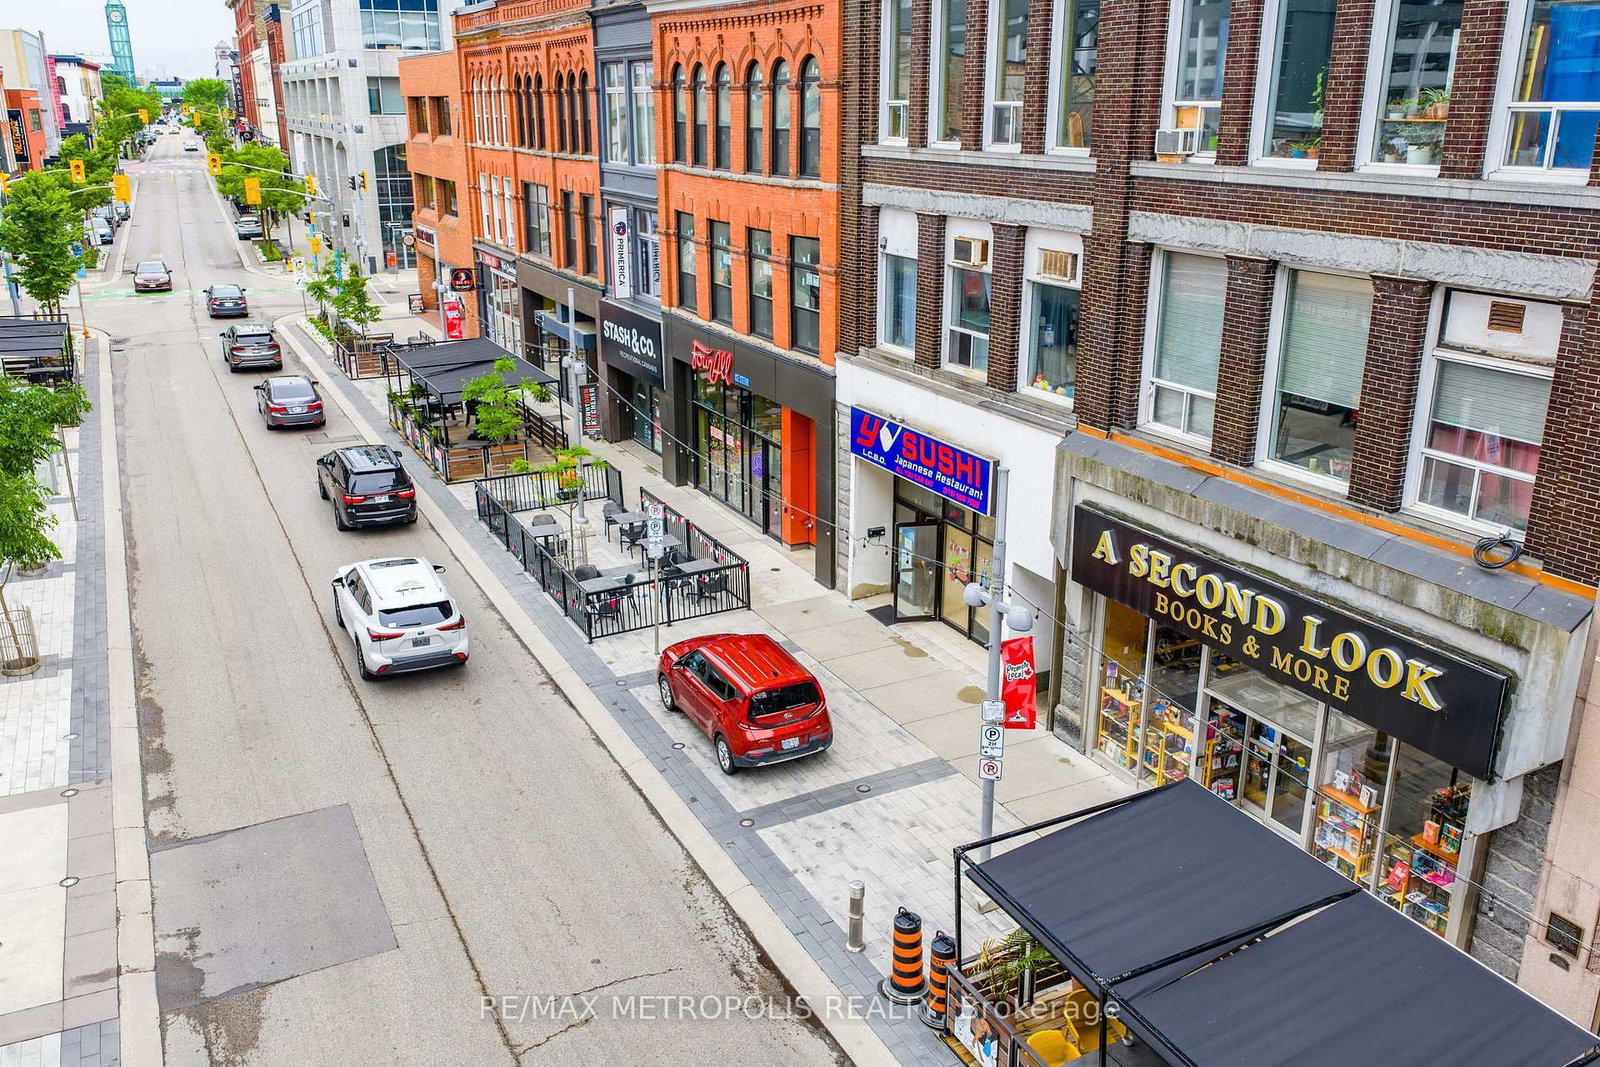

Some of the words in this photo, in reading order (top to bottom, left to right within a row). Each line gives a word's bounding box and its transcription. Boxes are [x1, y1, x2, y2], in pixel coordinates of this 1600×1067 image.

[234, 76, 244, 113] WALPER
[617, 238, 626, 286] PRIMERICA
[582, 388, 591, 426] DOWNTOWN
[589, 387, 598, 425] KITCHENER
[862, 448, 886, 465] L.C.B.O.
[902, 432, 981, 487] SUSHI
[894, 454, 933, 478] Japanese
[935, 472, 984, 500] Restaurant
[1091, 529, 1120, 566] A
[1129, 543, 1287, 636] SECOND
[1299, 614, 1444, 713] LOOK
[1154, 592, 1233, 647] BOOKS
[1242, 634, 1260, 660] &
[1270, 645, 1350, 702] MORE
[1006, 661, 1029, 675] Promote
[1007, 670, 1024, 681] Local
